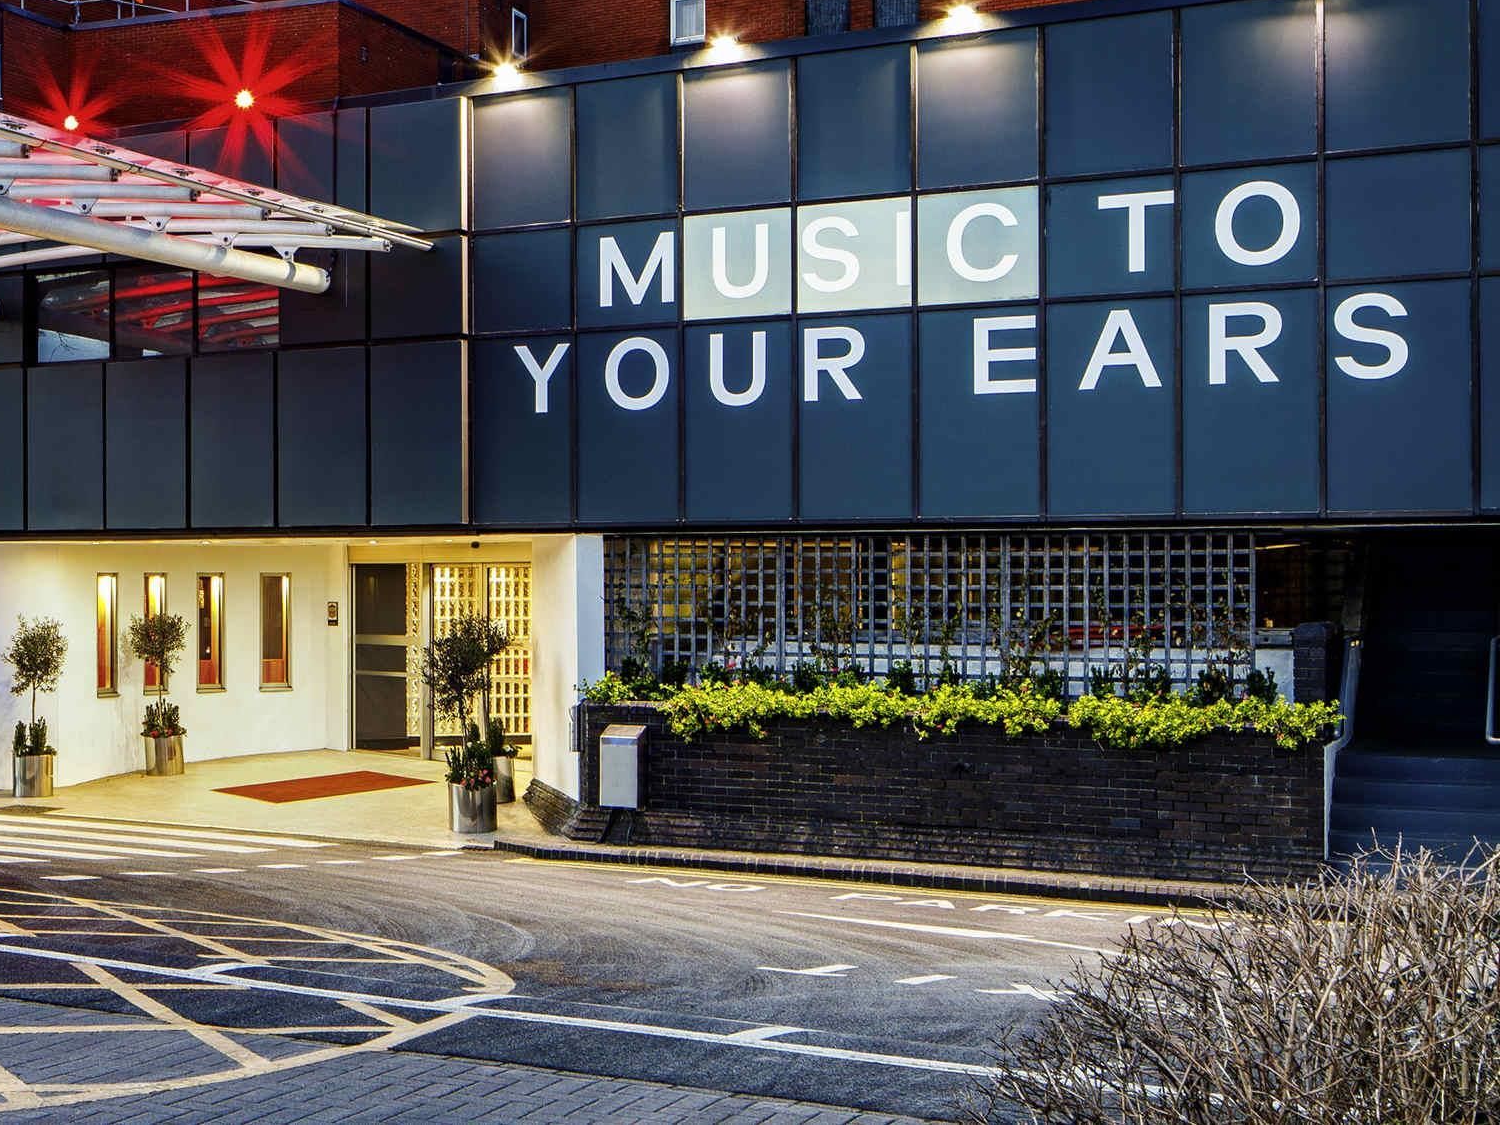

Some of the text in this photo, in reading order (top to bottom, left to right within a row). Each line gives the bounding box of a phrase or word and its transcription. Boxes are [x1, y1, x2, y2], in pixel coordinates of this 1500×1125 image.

[599, 180, 1301, 307] MUSIC TO
[513, 292, 1409, 414] YOUR EARS
[626, 877, 767, 892] NO
